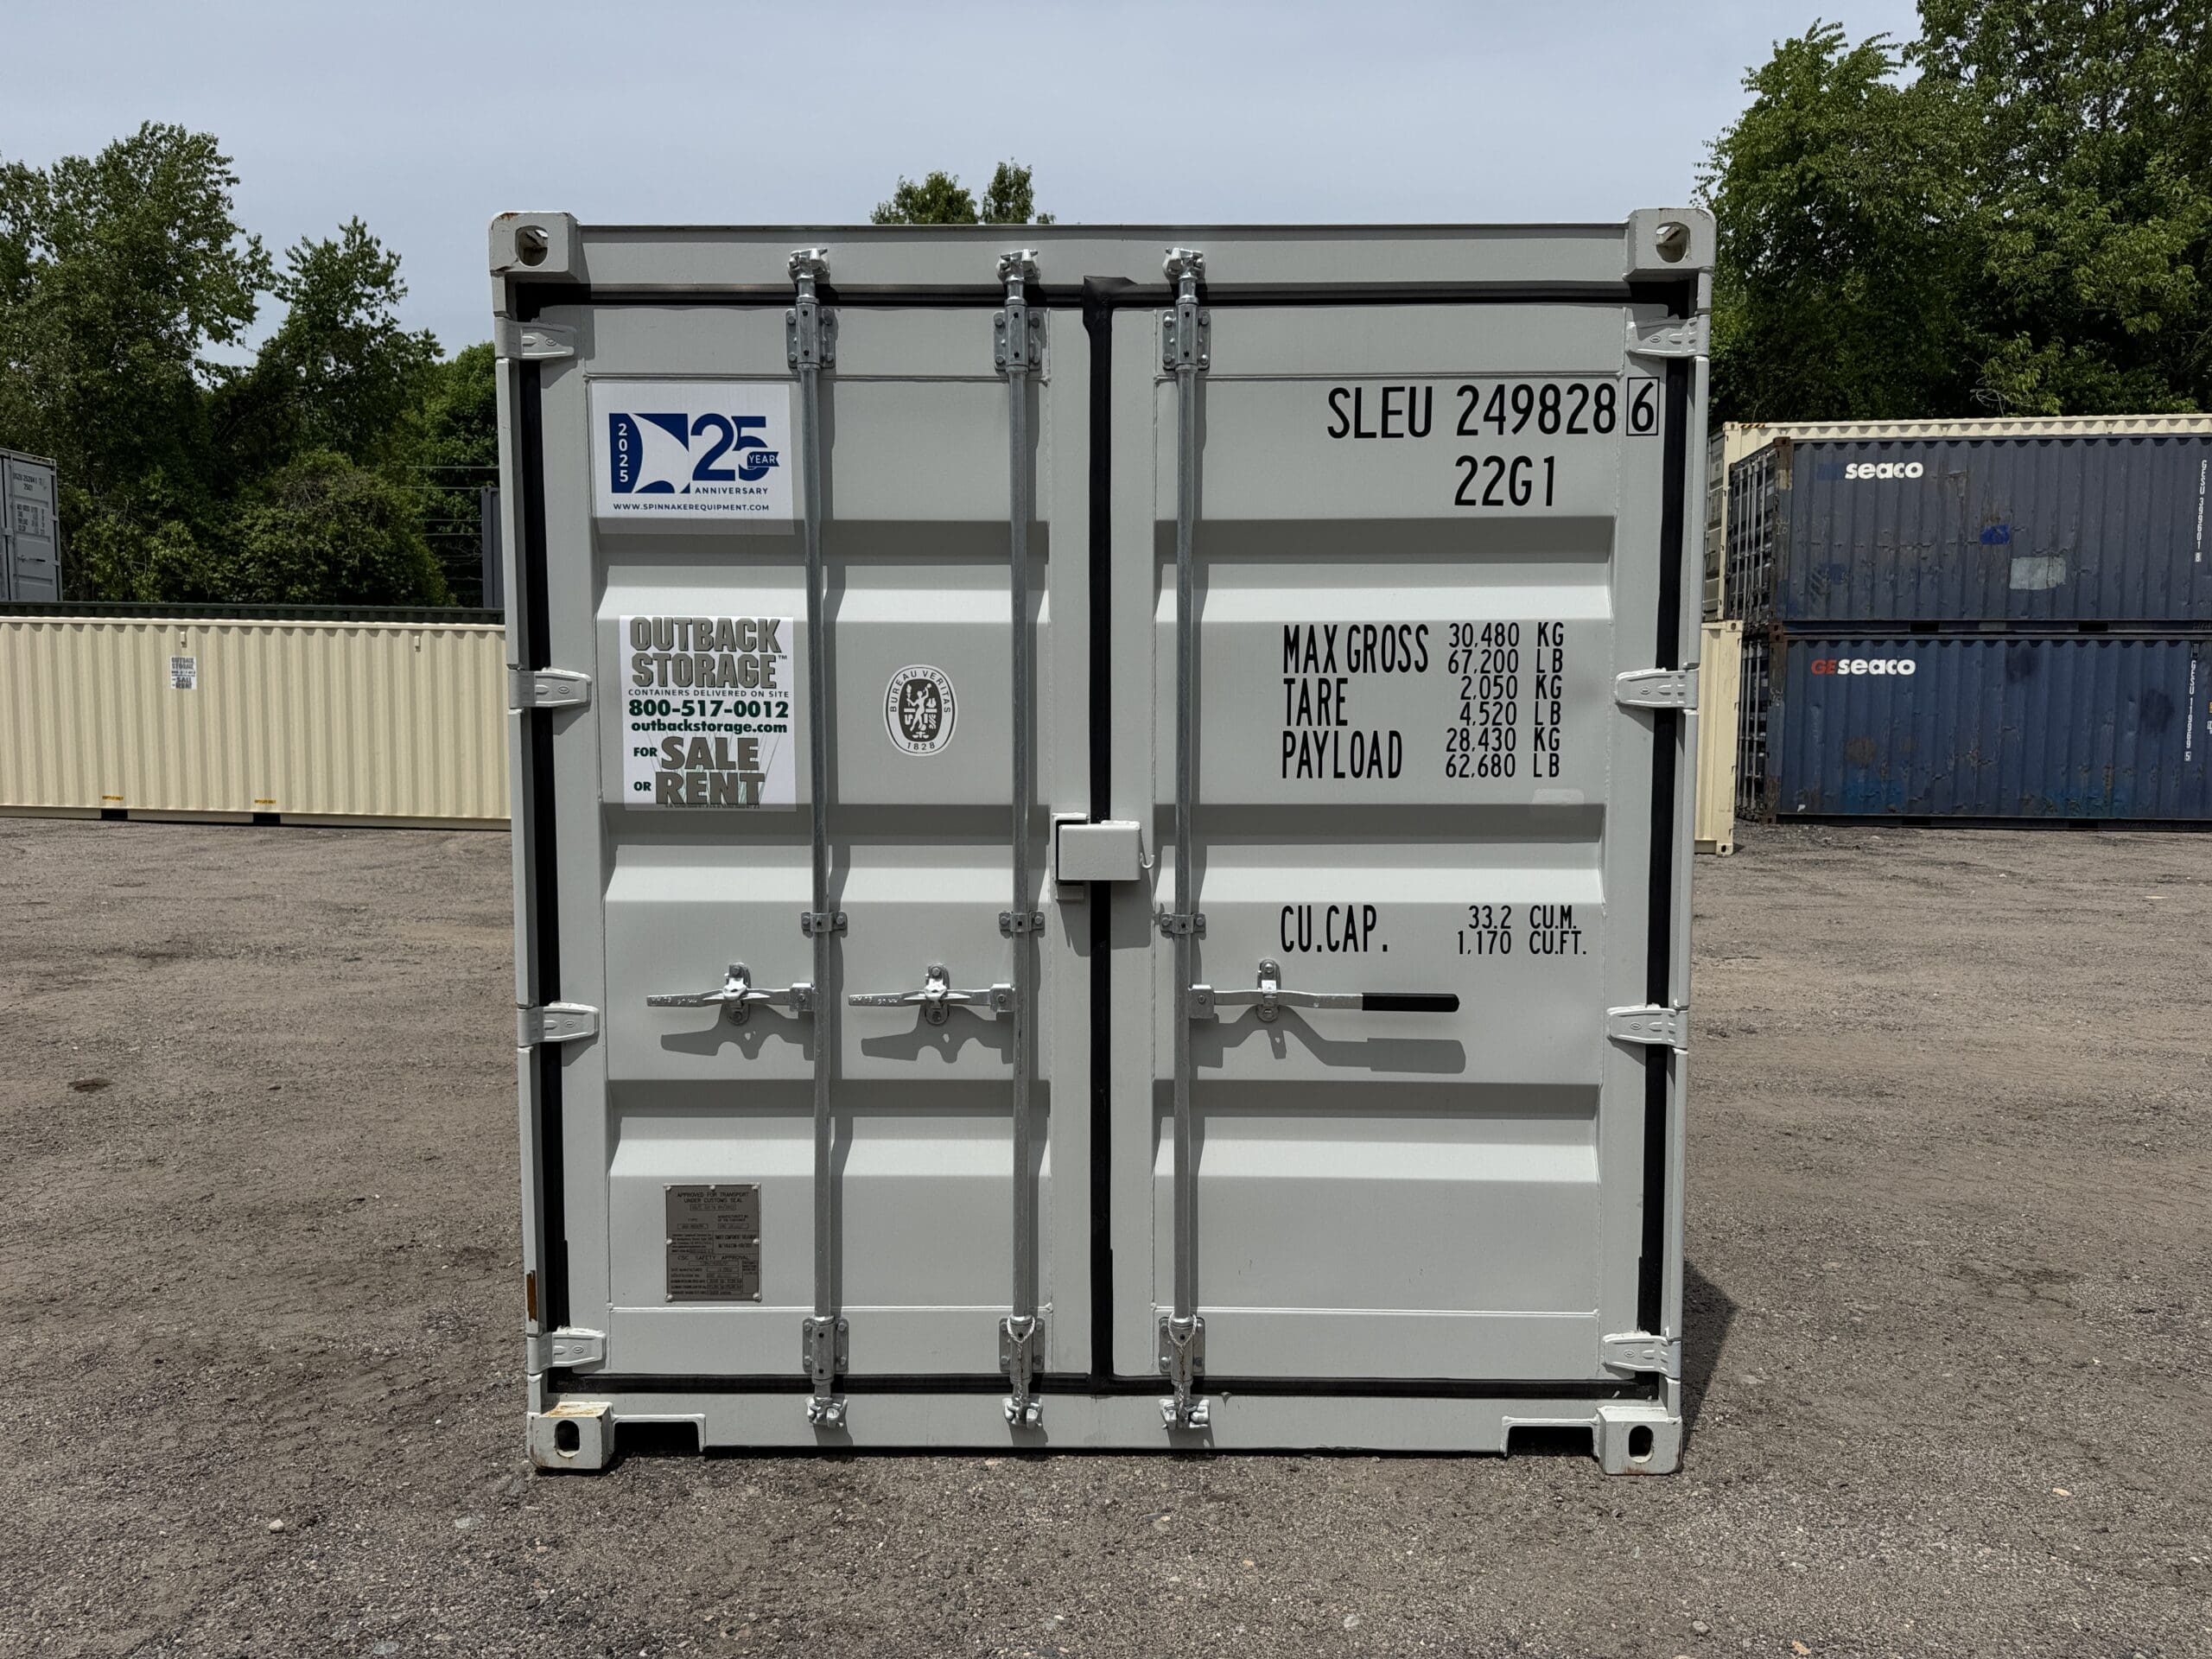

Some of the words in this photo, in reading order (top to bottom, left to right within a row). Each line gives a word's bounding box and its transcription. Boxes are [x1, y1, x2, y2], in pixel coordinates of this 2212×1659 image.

[1327, 386, 1433, 439] SLEU
[1456, 383, 1617, 436] 249828
[1630, 381, 1655, 432] 6
[618, 423, 629, 482] 2025
[690, 412, 771, 481] 25
[748, 454, 775, 464] YEAR
[1454, 454, 1555, 507] 22G1
[1845, 461, 1923, 479] seaco
[613, 503, 770, 512] WWW.SPINNAKEREQUIPMENT.COM
[695, 486, 768, 495] ANNIVERSARY
[630, 616, 782, 653] OUTBACK
[1283, 624, 1338, 674] MAX
[1346, 624, 1430, 674] GROSS
[1537, 622, 1564, 647] KG
[632, 652, 777, 689] STORAGE
[1535, 649, 1563, 674] LB
[628, 698, 790, 718] 800-517-0012
[889, 670, 918, 713] BUREAU
[922, 670, 951, 713] VERITAS
[1283, 677, 1349, 727] TARE
[1535, 675, 1563, 700] KG
[631, 719, 788, 734] outbackstorage.com
[1534, 701, 1561, 726] LB
[633, 747, 658, 757] FOR
[661, 736, 760, 771] SALE
[907, 741, 936, 751] 1828
[1282, 730, 1402, 779] PAYLOAD
[1534, 728, 1560, 752] KG
[1533, 753, 1560, 778] LB
[633, 781, 652, 791] OR
[655, 771, 766, 805] RENT
[1281, 905, 1389, 953] CU.CAP.
[1468, 905, 1512, 930] 33.2
[1529, 905, 1577, 930] CU.M.
[1529, 931, 1587, 955] CU.FT.
